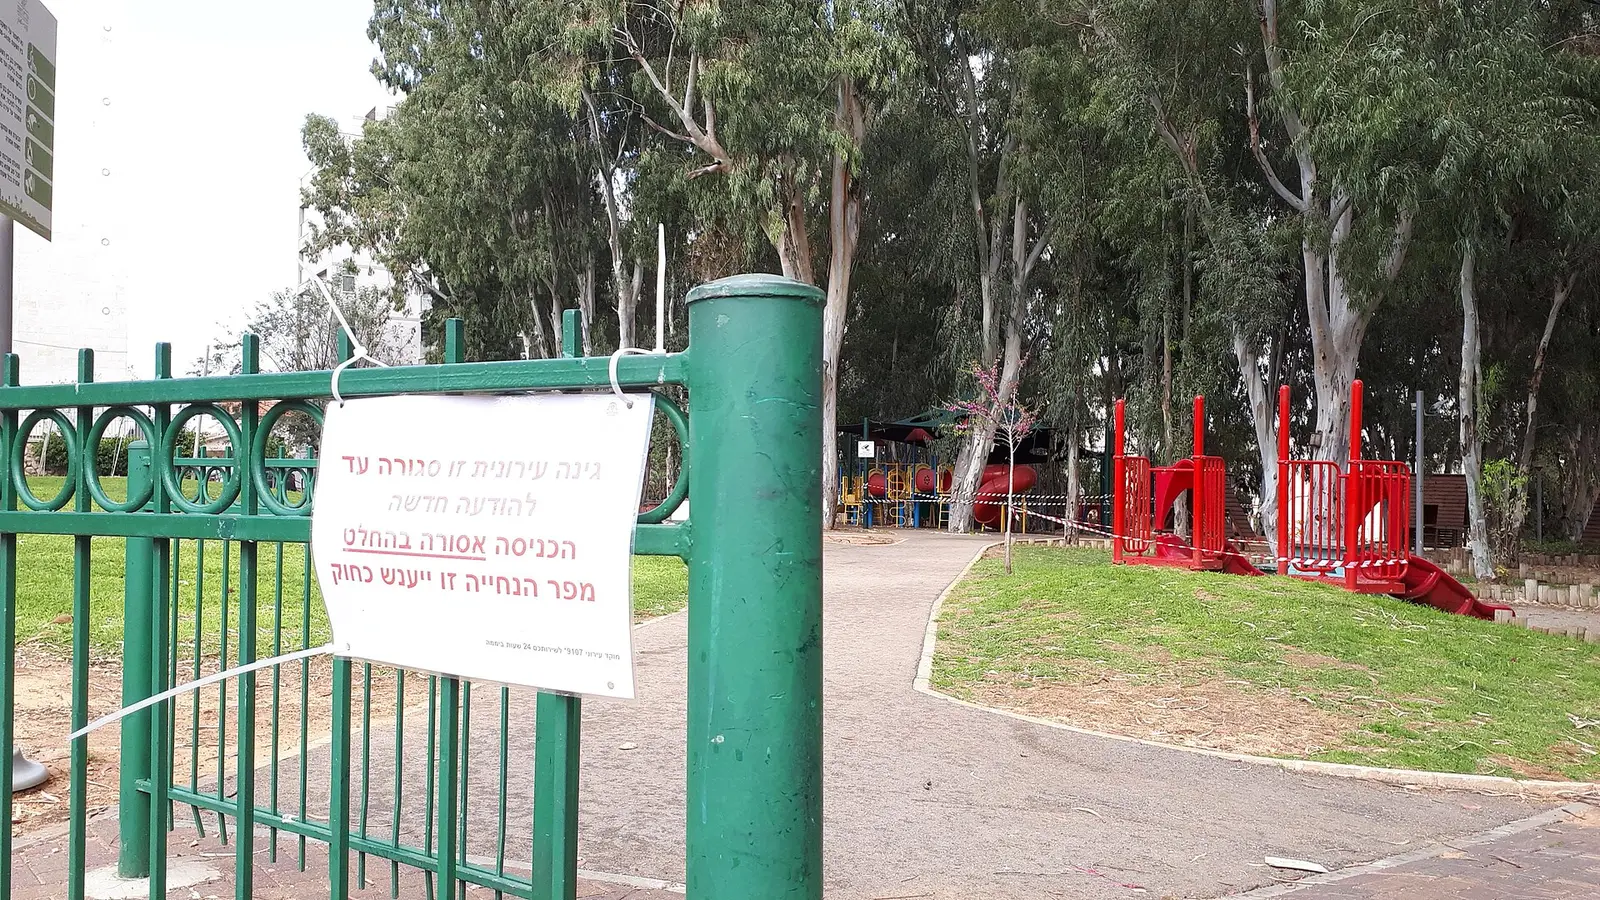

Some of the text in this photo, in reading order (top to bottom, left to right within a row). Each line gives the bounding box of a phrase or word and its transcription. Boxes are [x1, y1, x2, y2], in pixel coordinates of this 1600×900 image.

[341, 455, 601, 481] גינה עירונית זו סגורה עד
[388, 491, 537, 517] להודעה חדשה
[343, 522, 576, 560] הכניסה אסורה בהחלט
[330, 562, 596, 602] מפר הנחייה זו ייענש כחוק
[522, 642, 532, 651] 24
